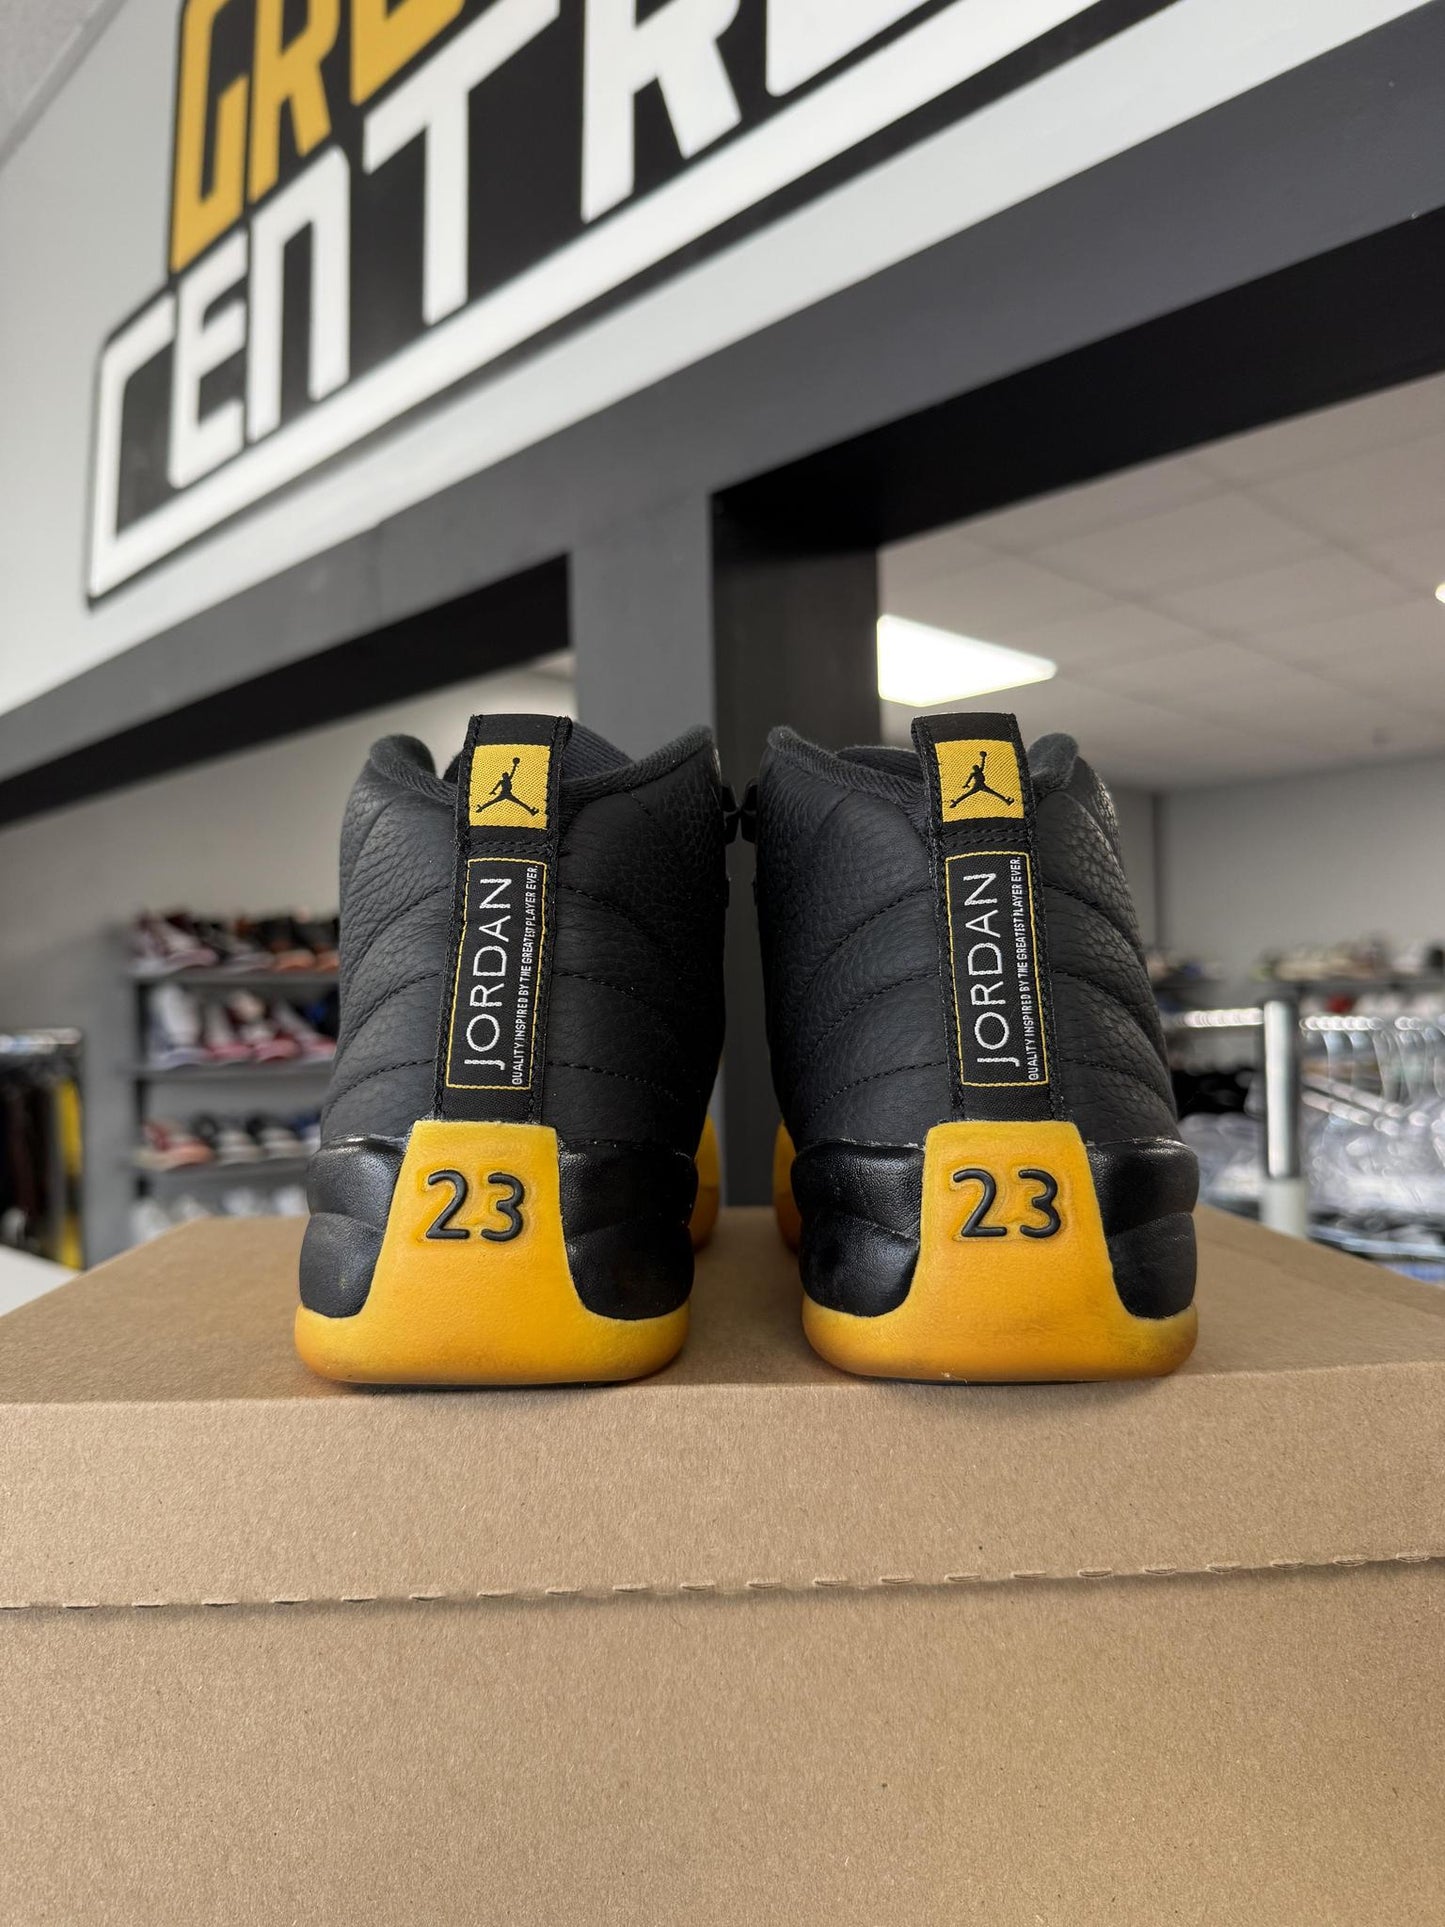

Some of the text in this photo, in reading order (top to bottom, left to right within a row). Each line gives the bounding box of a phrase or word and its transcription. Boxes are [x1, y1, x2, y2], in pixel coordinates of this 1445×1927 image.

[169, 0, 466, 274] GR
[464, 878, 512, 1071] JORDAN
[511, 865, 538, 1085] QUALITY INSPIRED BY THE GREATEST PLAYER EVER.
[963, 873, 1020, 1067] JORDAN
[1010, 856, 1039, 1081] QUALITY INSPIRED BY THE GREATEST PLAYER EVER.
[425, 1169, 525, 1242] 23
[953, 1168, 1061, 1239] 23
